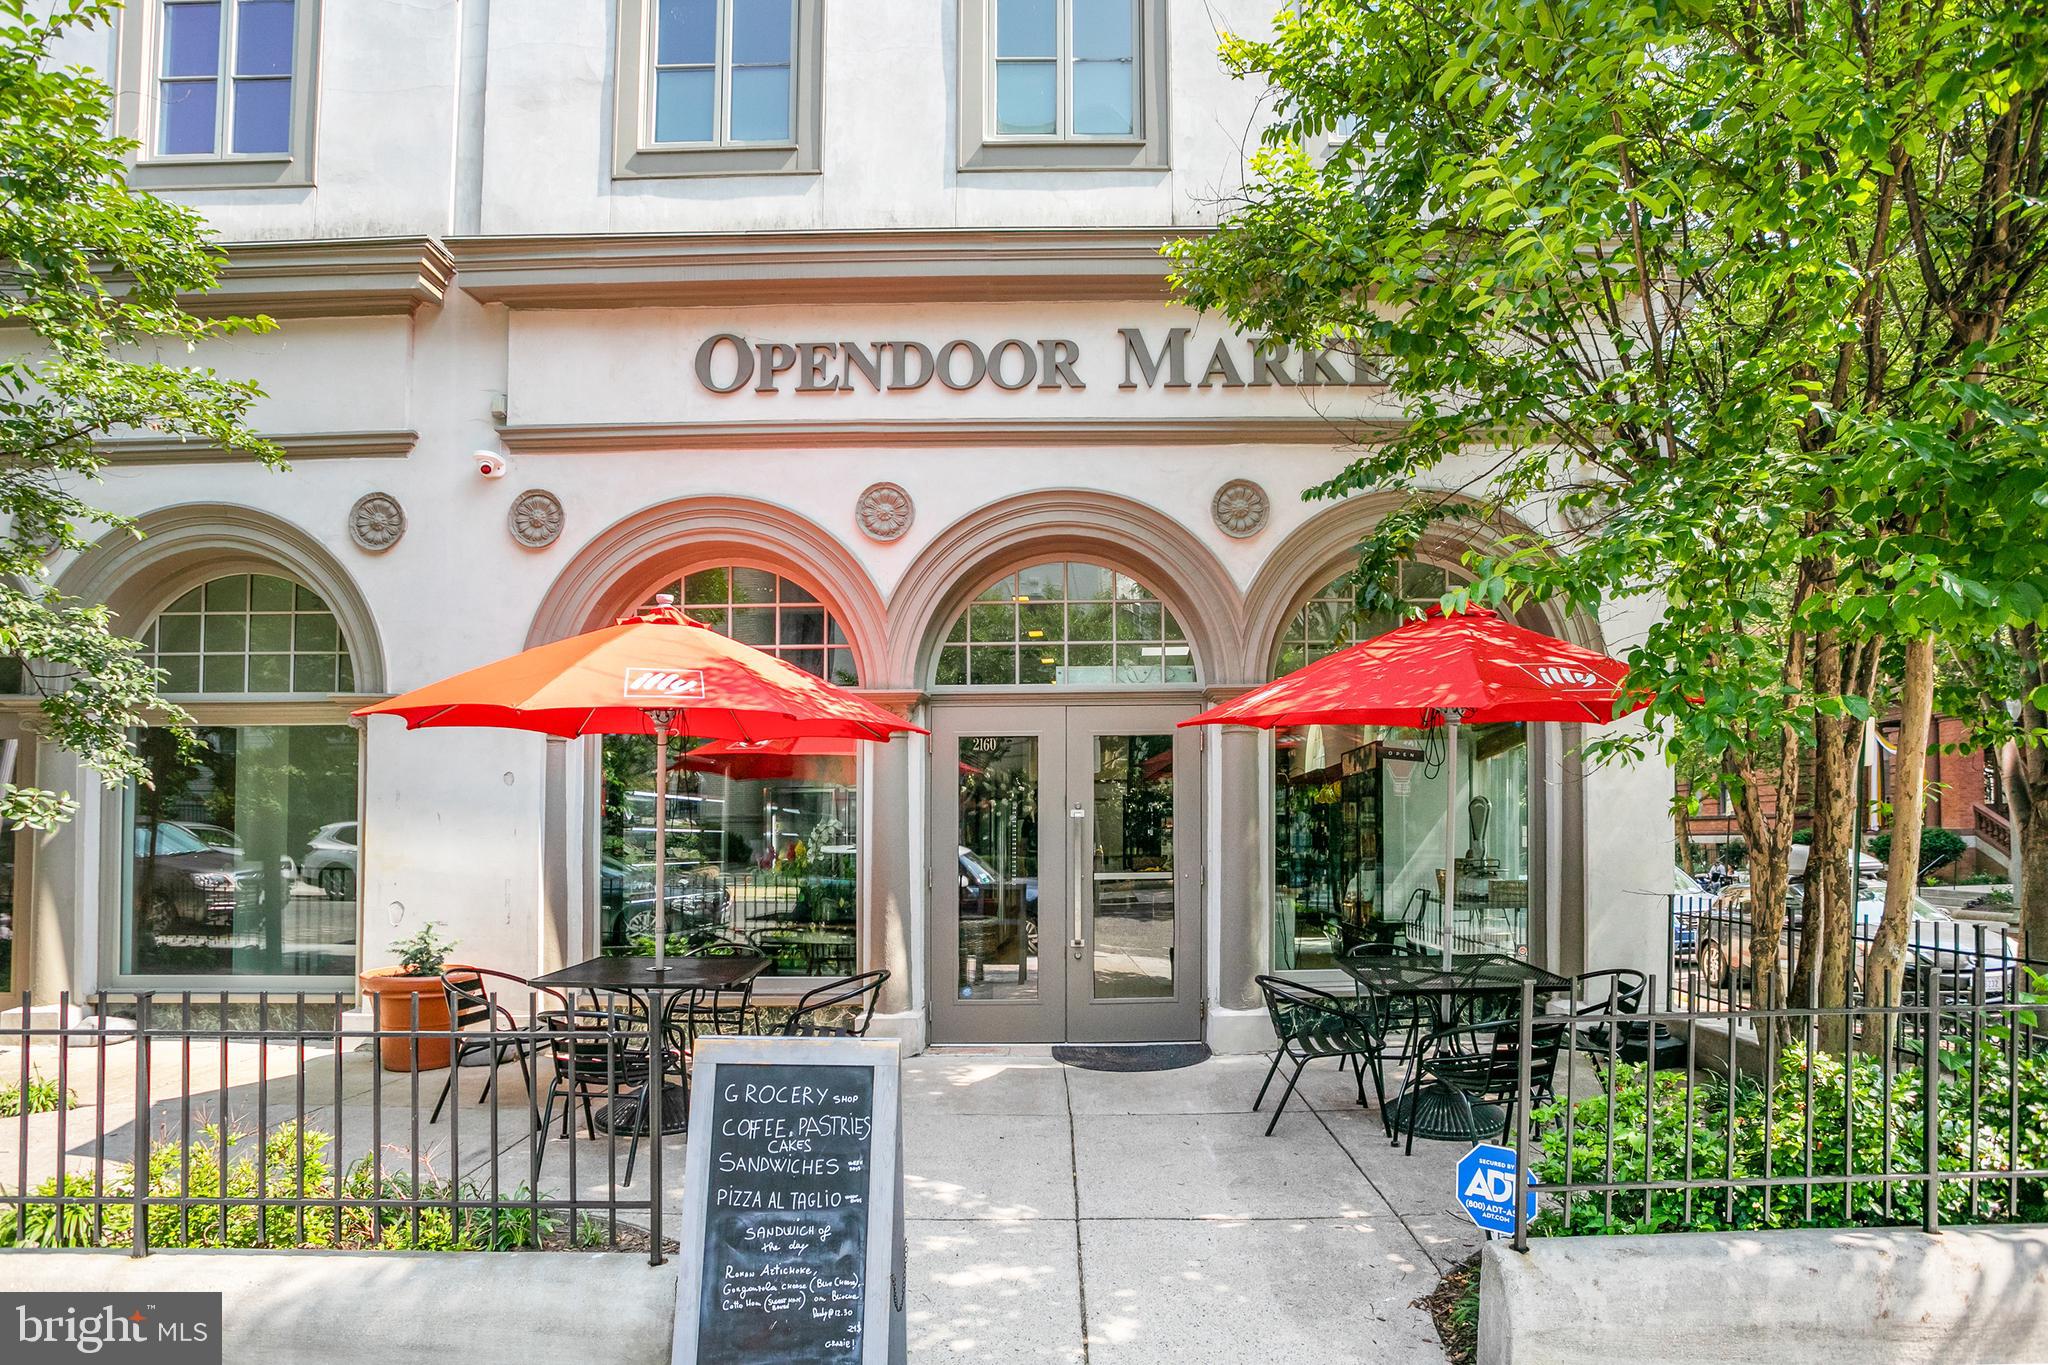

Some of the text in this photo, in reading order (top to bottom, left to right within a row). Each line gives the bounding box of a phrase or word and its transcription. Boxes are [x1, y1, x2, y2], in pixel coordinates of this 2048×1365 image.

[694, 327, 1393, 393] OPENDOOR MARKE
[630, 672, 698, 695] illy
[1538, 667, 1597, 688] illy
[972, 737, 998, 752] 2160
[1388, 750, 1415, 758] OPEN
[724, 1083, 859, 1106] GROCERY SHOP
[798, 1112, 871, 1141] PASTRIES
[767, 1138, 812, 1154] CAKES
[719, 1152, 840, 1175] SANDWICHES
[1479, 1158, 1506, 1169] SECURED
[717, 1185, 762, 1208] PIZZA
[768, 1191, 785, 1209] AL
[790, 1189, 842, 1210] TAGLIO
[1465, 1199, 1486, 1212] (800)
[1482, 1211, 1510, 1223] ADT.COM
[744, 1224, 832, 1242] SANDWICH of
[761, 1239, 810, 1256] the day
